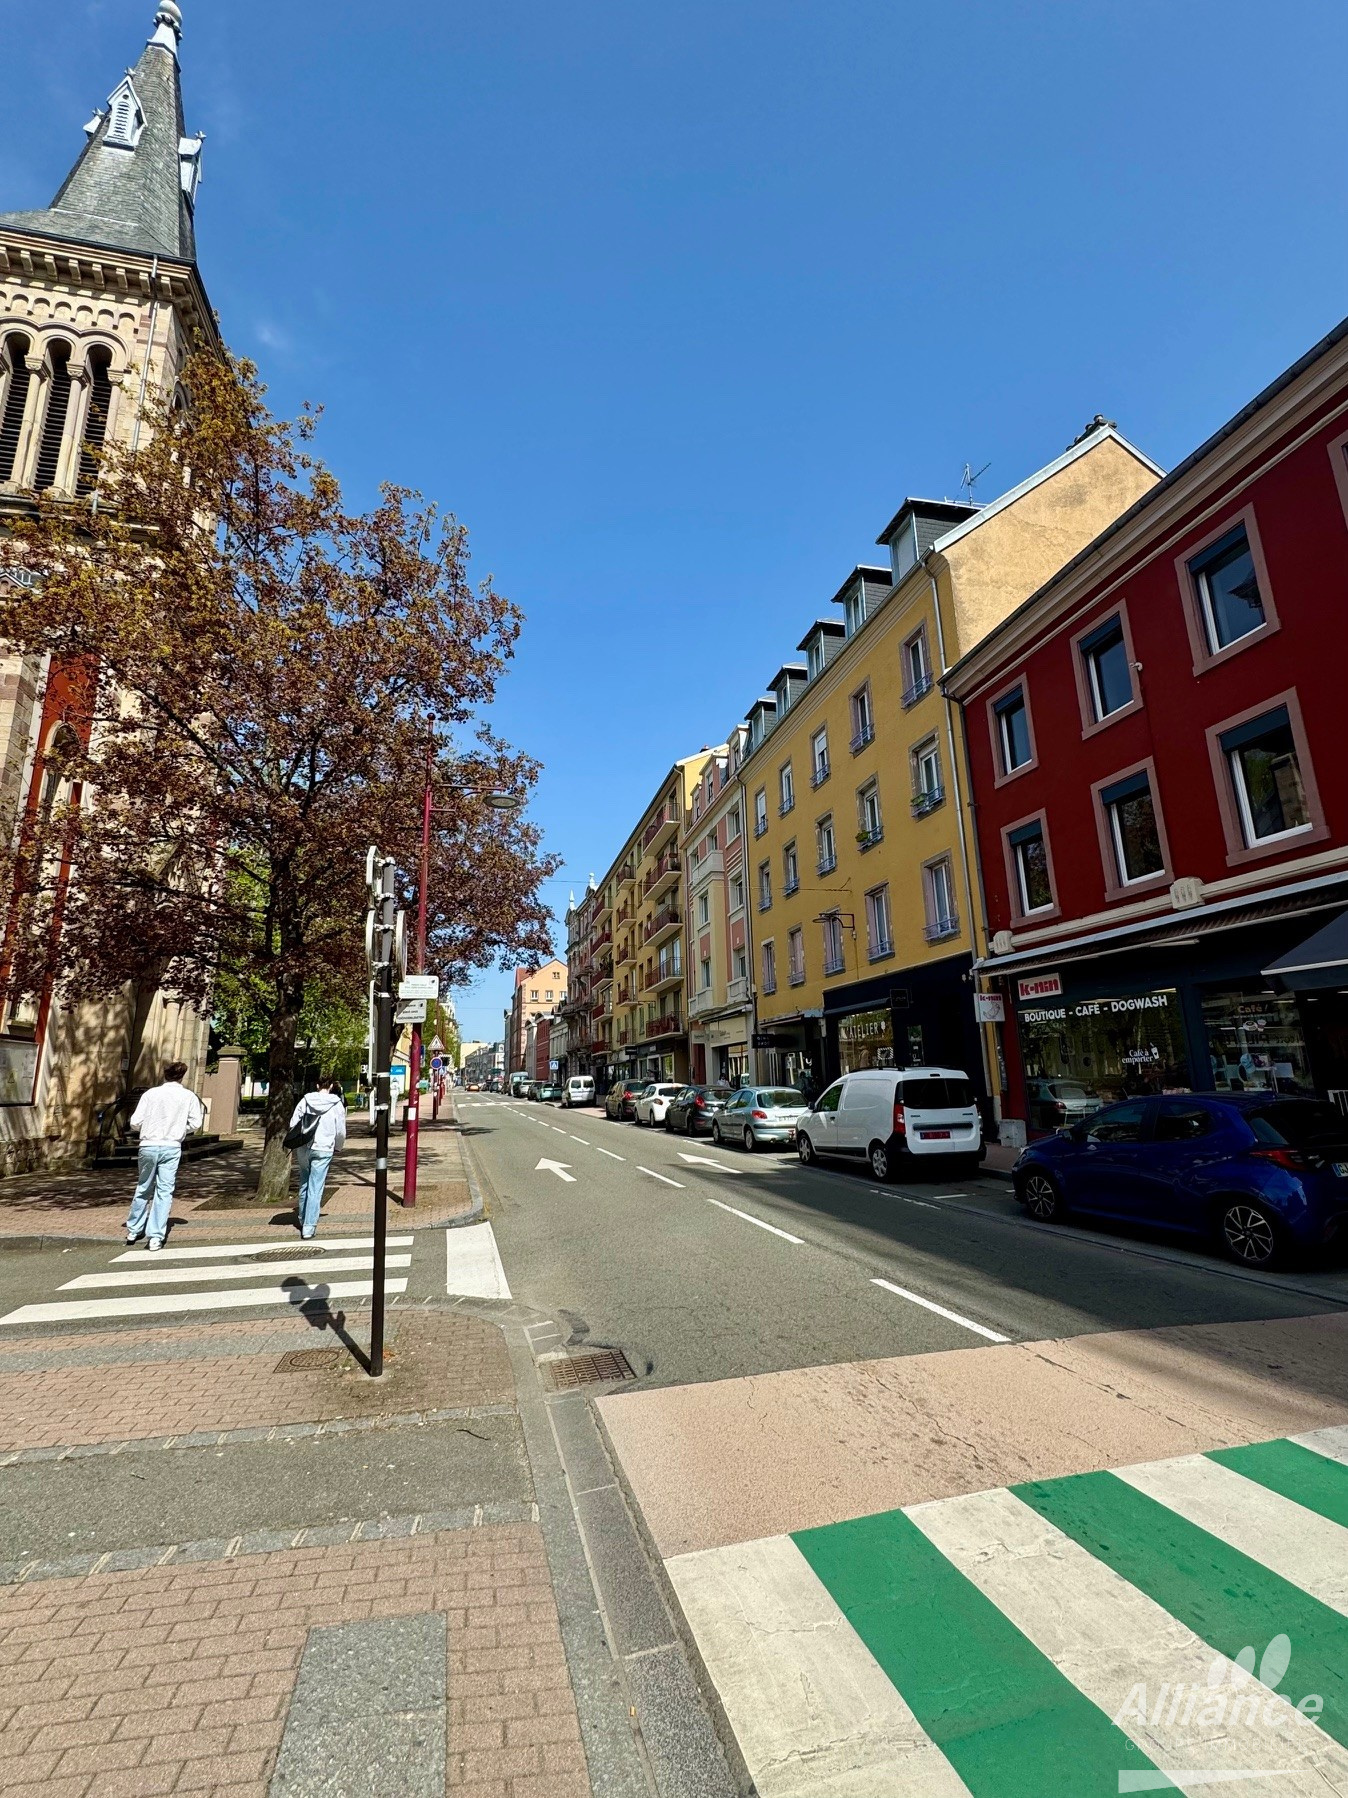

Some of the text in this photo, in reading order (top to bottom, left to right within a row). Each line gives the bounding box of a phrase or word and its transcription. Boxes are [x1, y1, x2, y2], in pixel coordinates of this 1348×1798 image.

[1020, 979, 1059, 997] k-nin
[1024, 1008, 1066, 1023] BOUTIQUE
[1075, 1001, 1101, 1017] CAFÉ
[1110, 994, 1168, 1013] DOGWASH
[1128, 1048, 1144, 1058] Café
[1121, 1055, 1154, 1066] emporter
